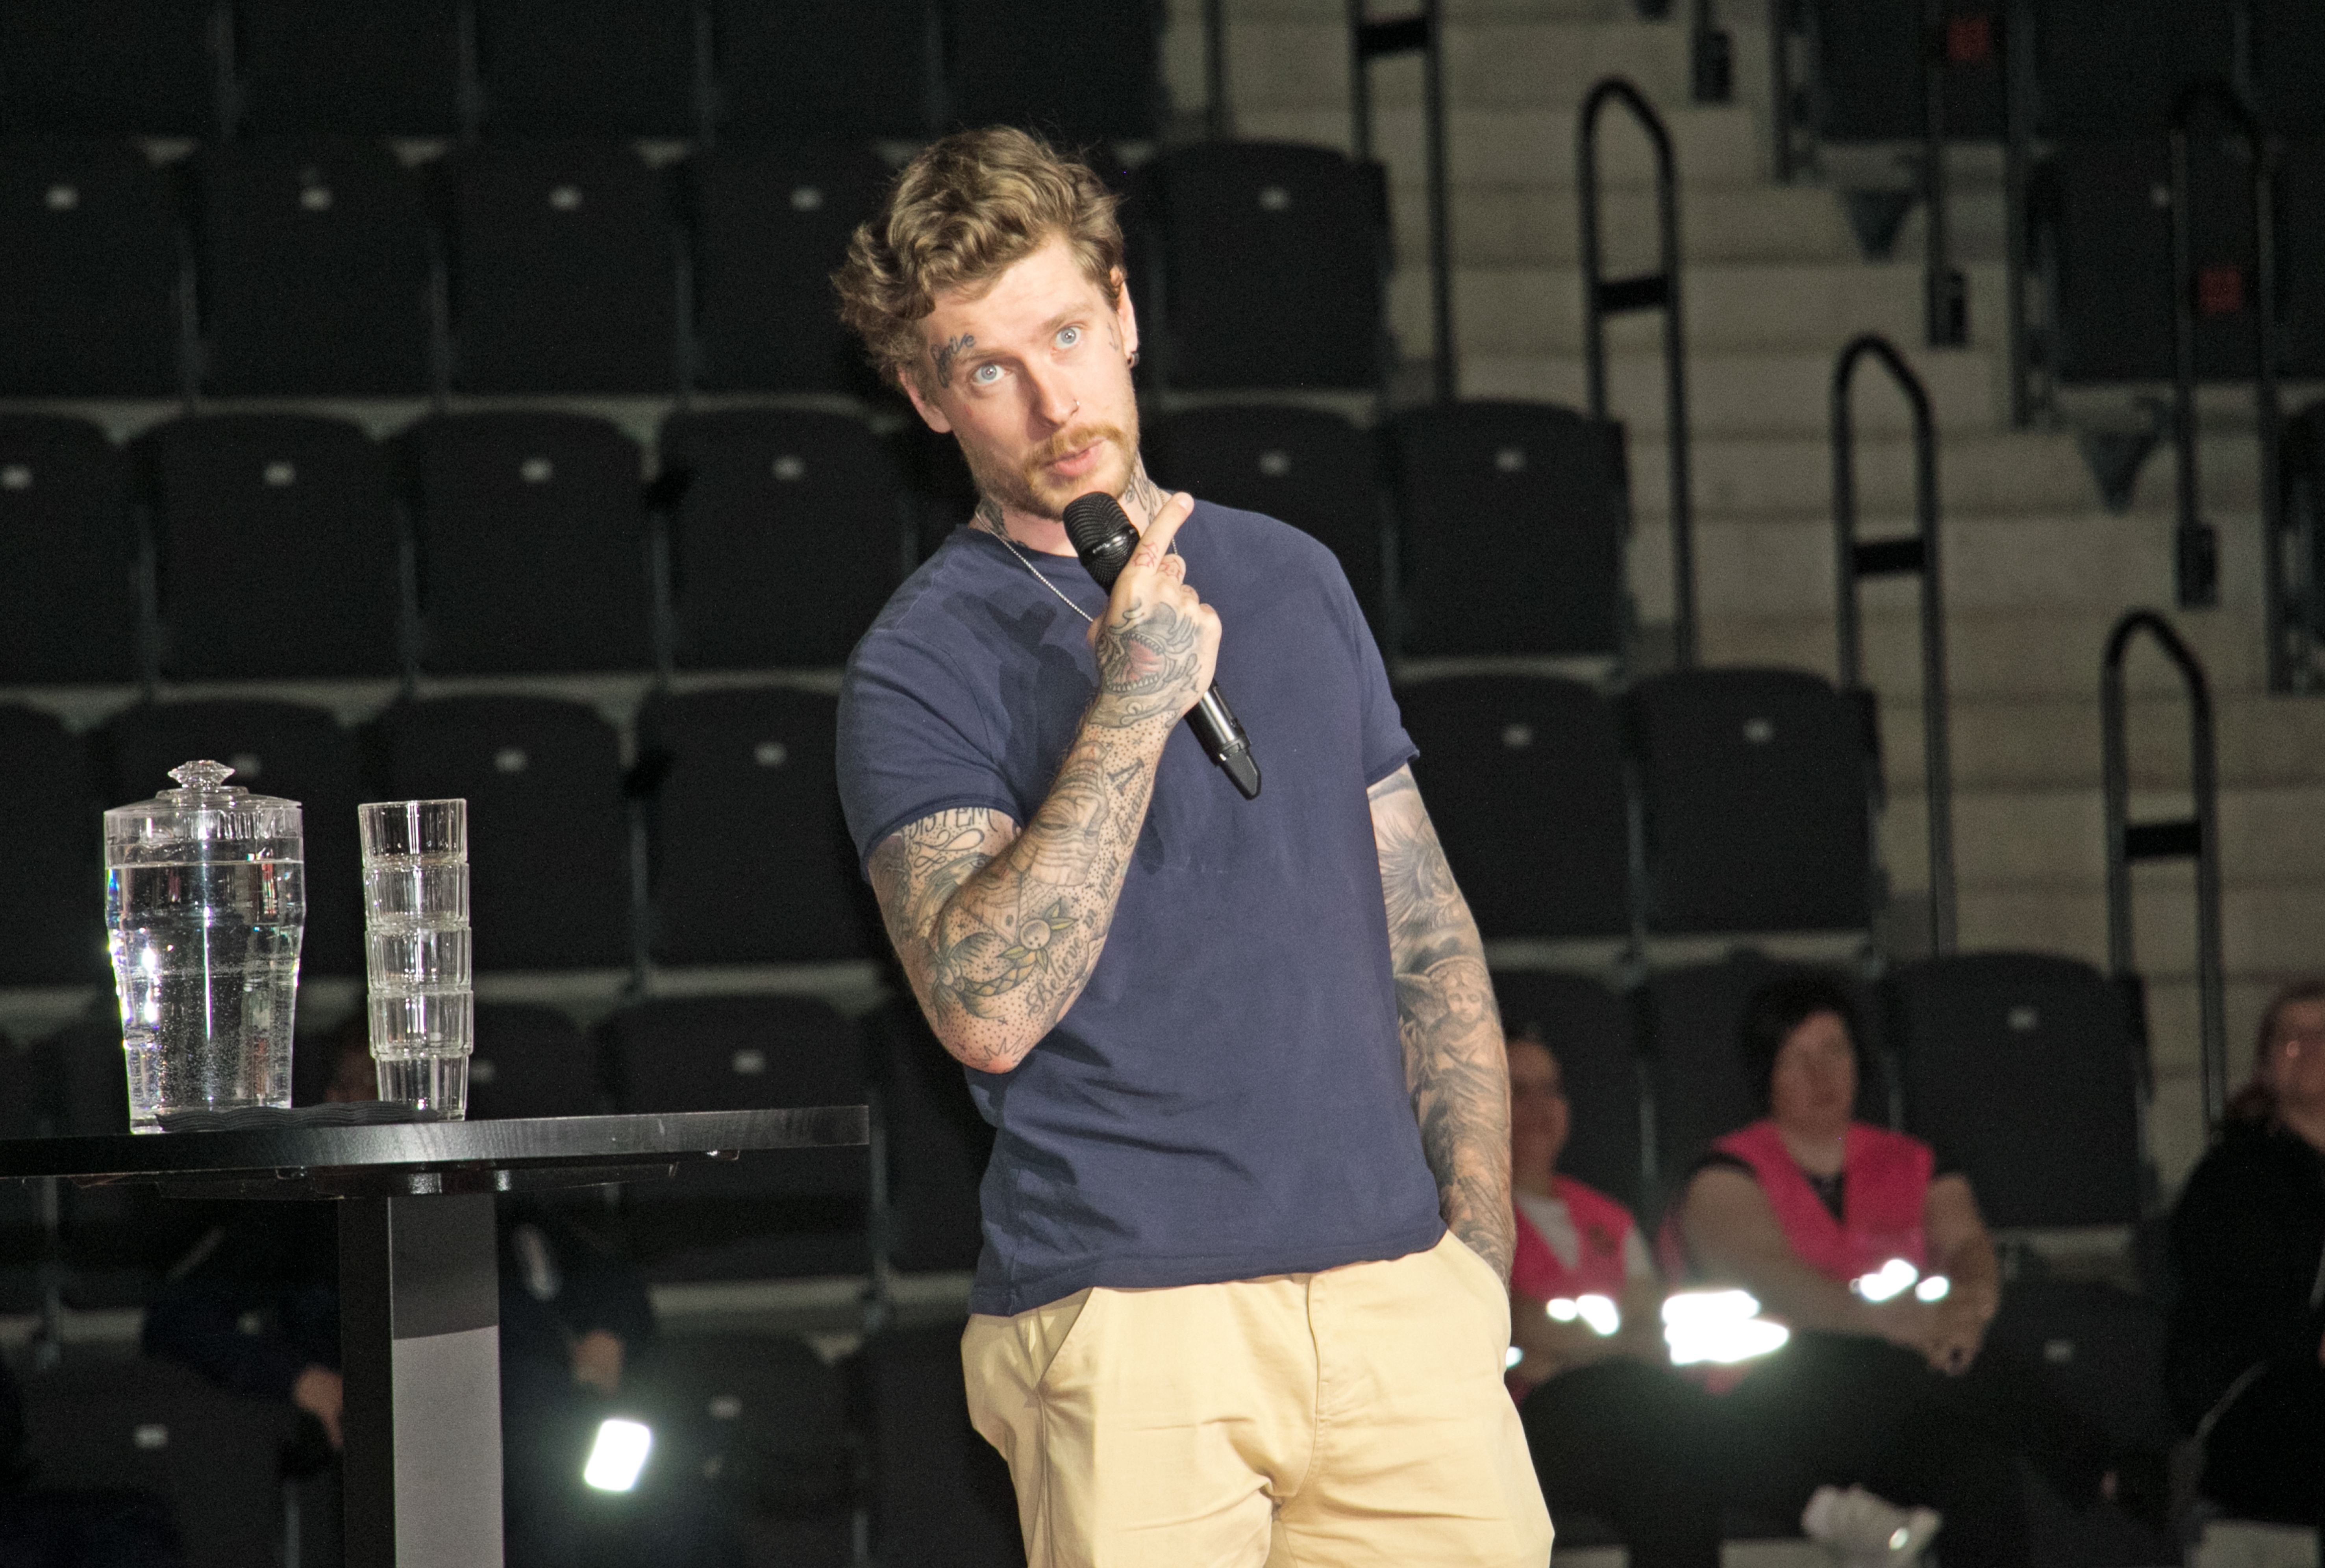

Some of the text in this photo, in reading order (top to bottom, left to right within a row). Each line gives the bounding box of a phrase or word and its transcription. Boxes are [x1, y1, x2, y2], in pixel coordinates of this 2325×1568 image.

[1026, 937, 1083, 1019] Believe
[1083, 909, 1098, 929] in
[1096, 852, 1120, 909] your
